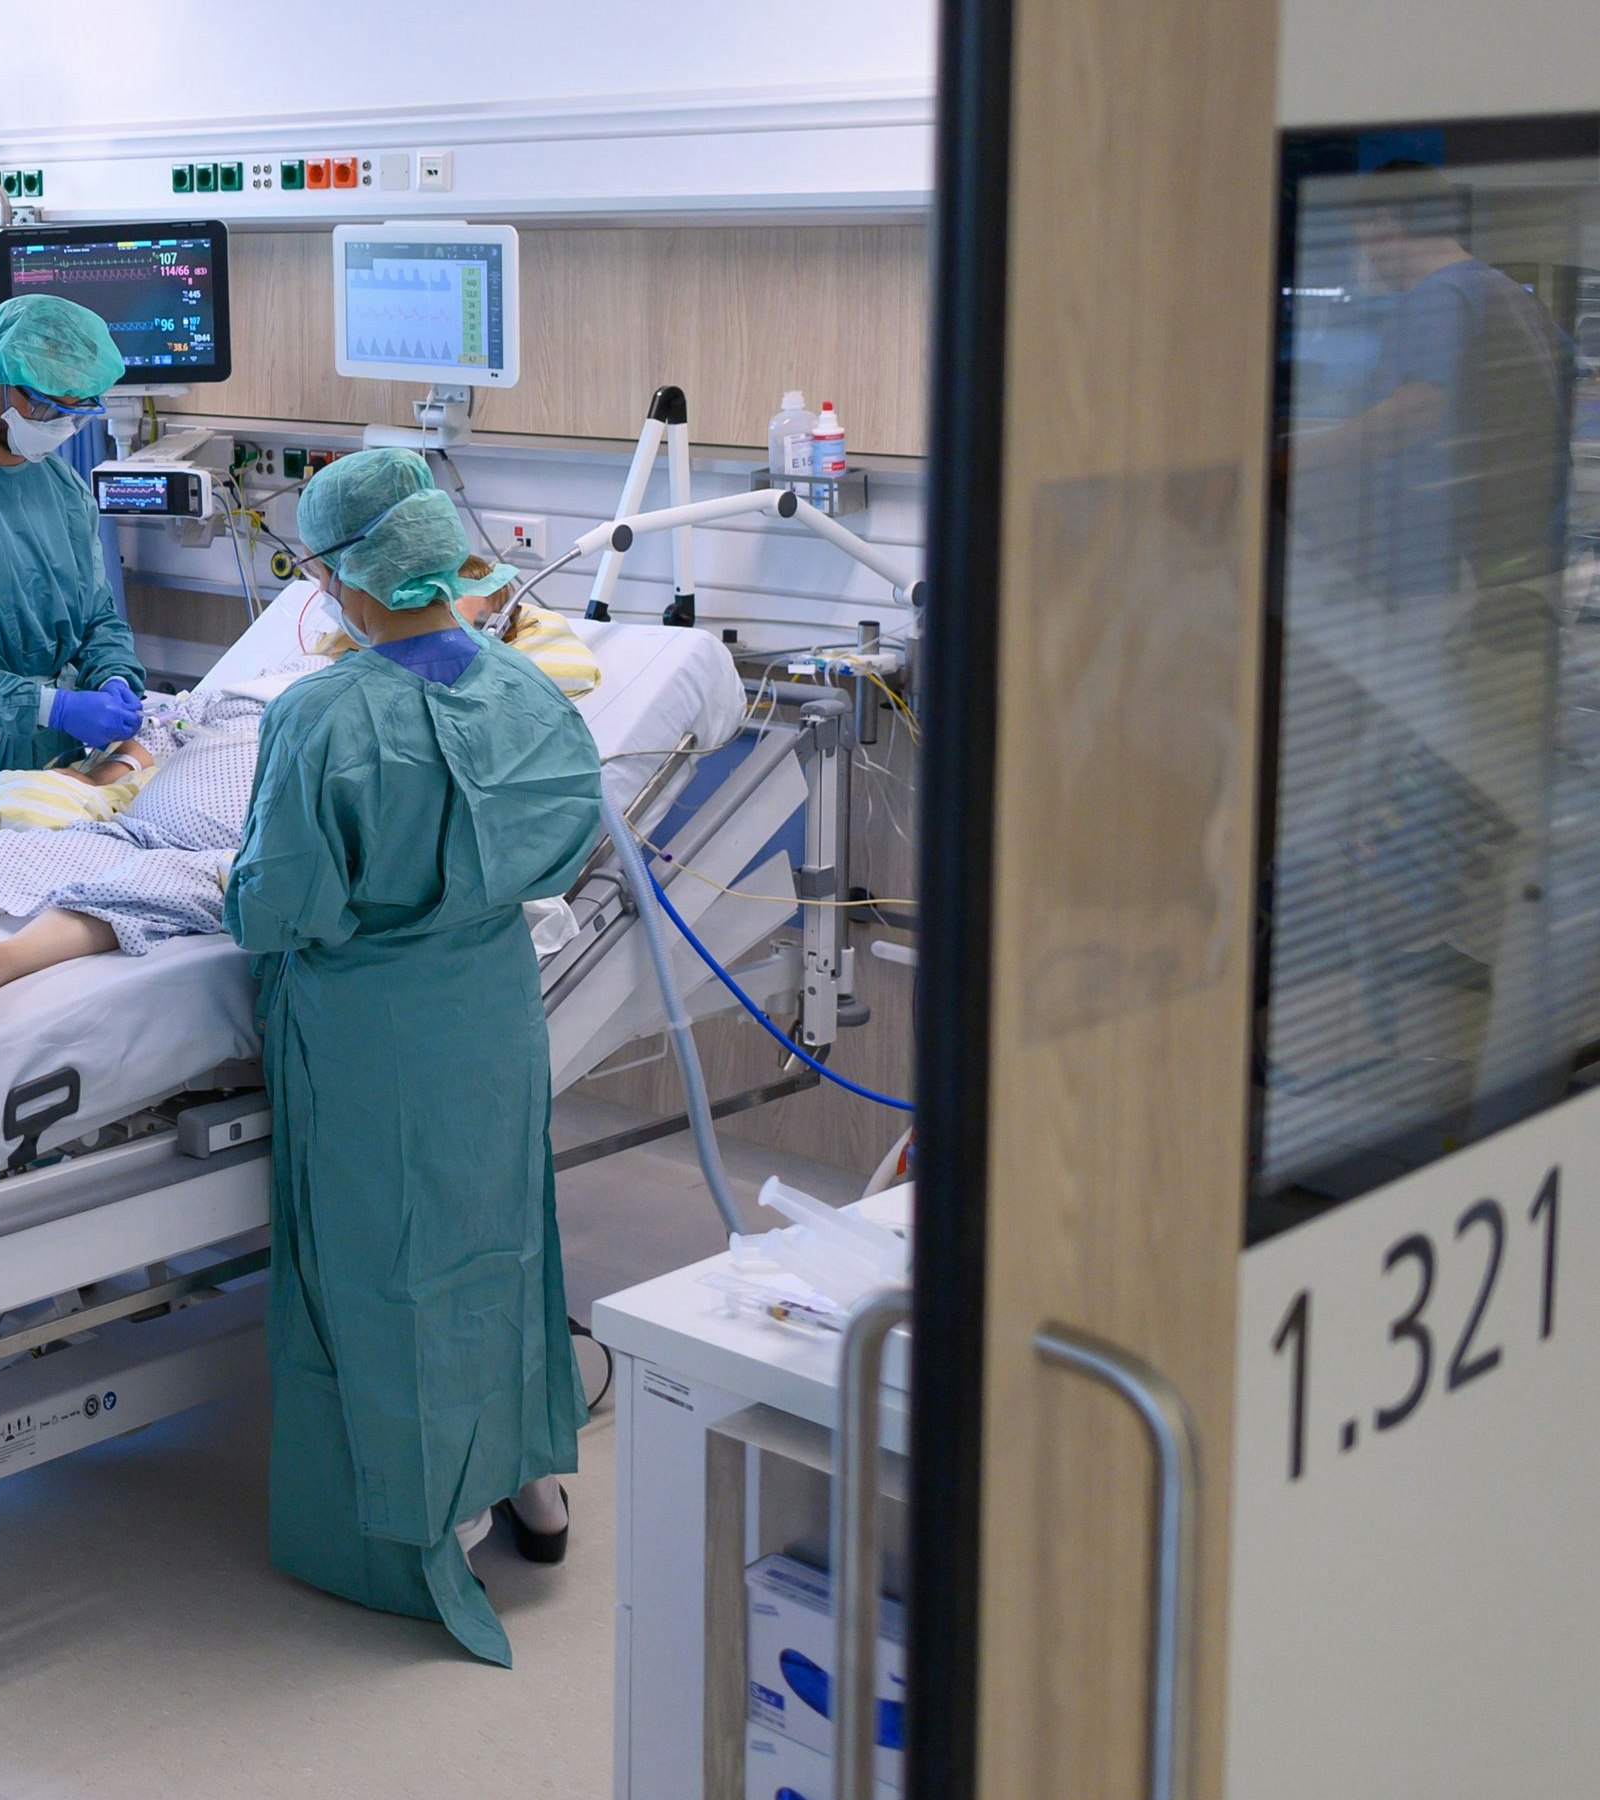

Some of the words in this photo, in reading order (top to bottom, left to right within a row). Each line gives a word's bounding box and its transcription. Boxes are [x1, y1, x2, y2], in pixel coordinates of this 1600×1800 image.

[160, 252, 177, 265] 107
[160, 265, 190, 277] 114/66
[161, 319, 175, 331] 96
[1271, 1160, 1561, 1482] 1.321
